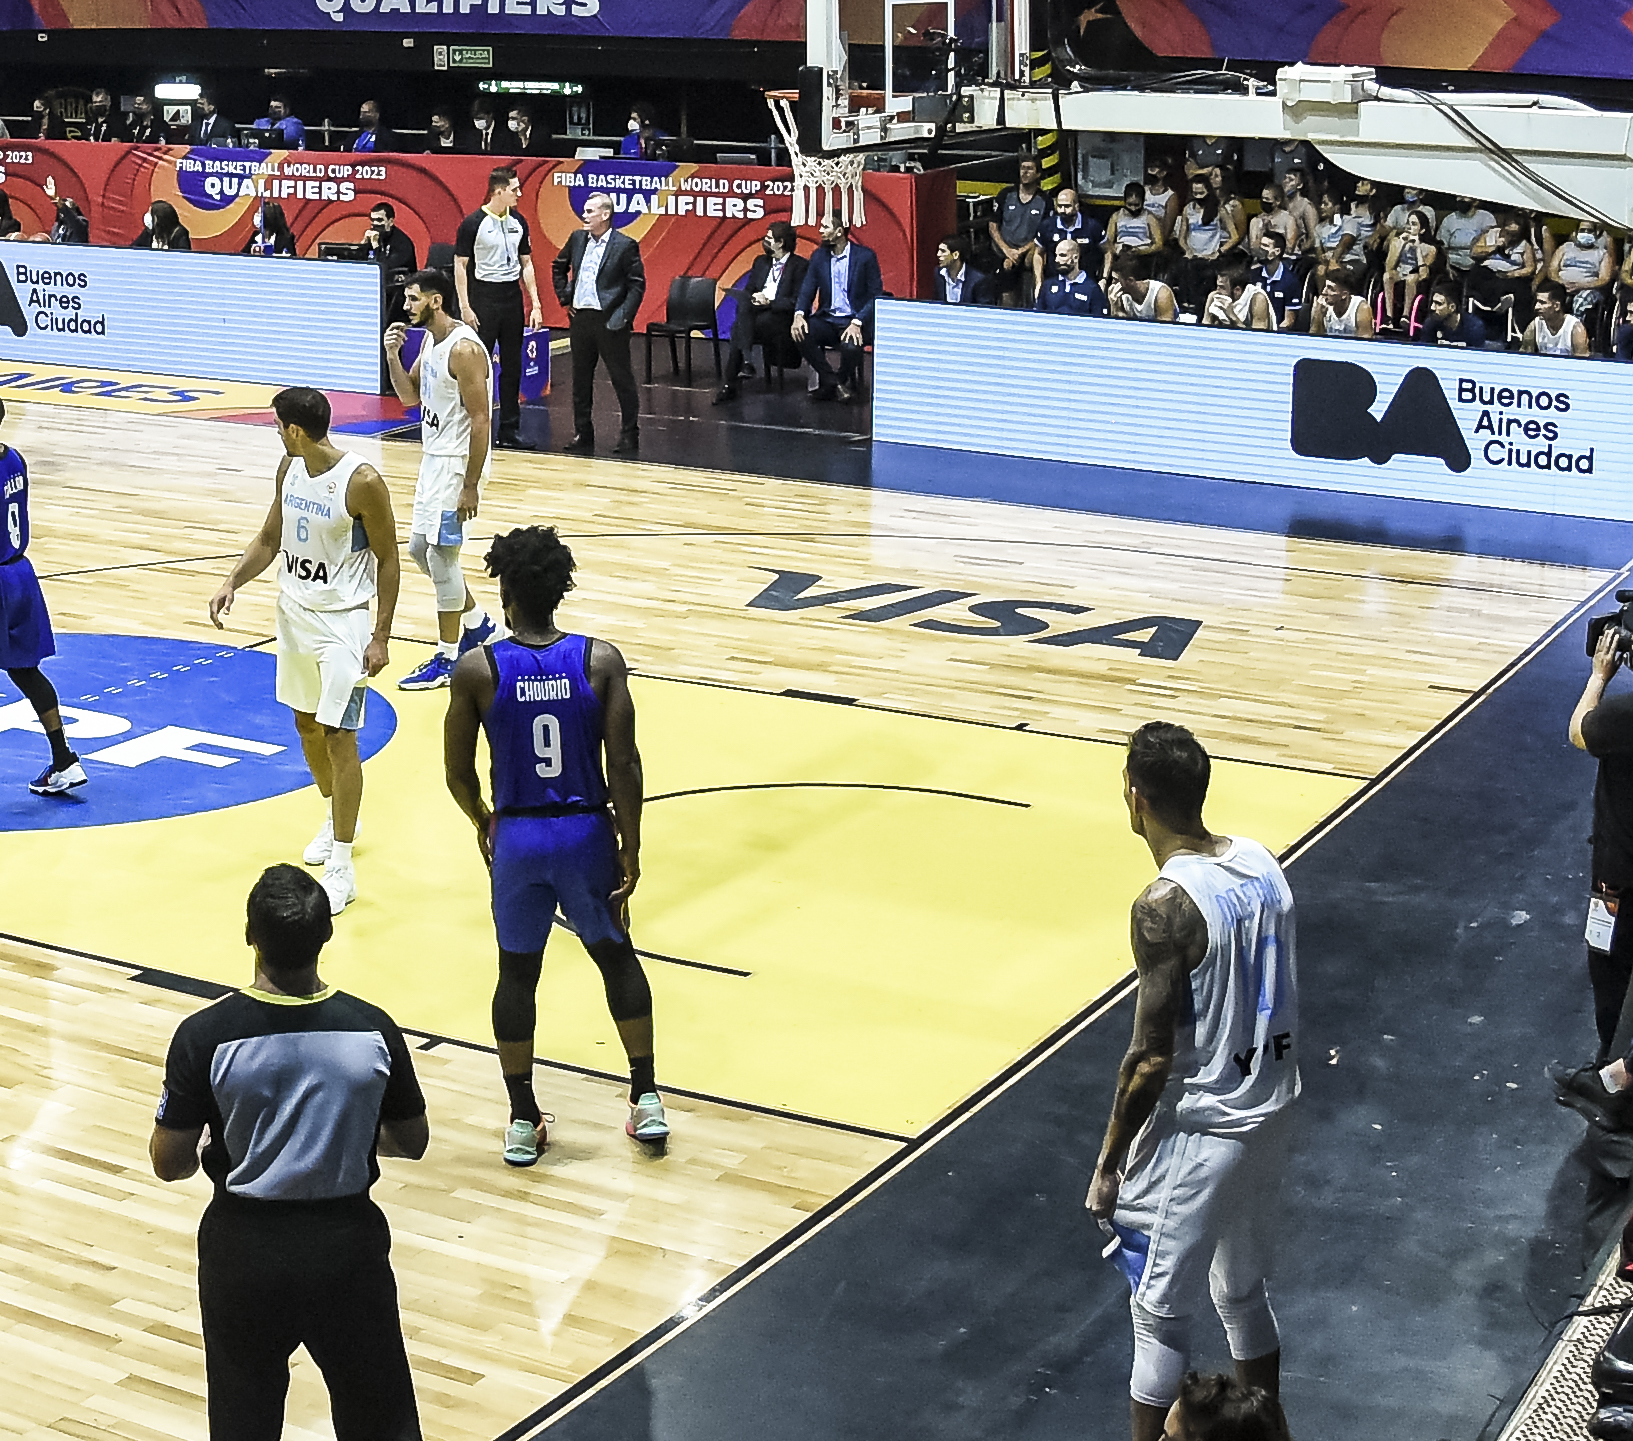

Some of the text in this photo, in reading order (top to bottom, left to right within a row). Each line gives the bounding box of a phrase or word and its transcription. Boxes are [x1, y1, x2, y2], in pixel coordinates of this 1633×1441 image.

[6, 151, 33, 164] 2023
[176, 159, 386, 180] FIBA BASKETBALL WORLD CUP 2023
[204, 176, 356, 202] QUALIFIERS
[553, 172, 584, 187] FIBA
[588, 173, 677, 191] BASKETBALL
[680, 177, 729, 193] WORLD
[732, 179, 761, 195] CUP
[15, 264, 88, 288] Buenos
[28, 288, 82, 311] Aires
[34, 310, 105, 336] Ciudad
[1457, 378, 1571, 412] Buenos
[1473, 409, 1559, 441] Aires
[1483, 439, 1595, 474] Ciudad
[283, 492, 331, 519] ARGENTINA
[296, 515, 310, 543] 6
[282, 548, 328, 585] VISA
[745, 565, 1204, 662] VISA
[516, 678, 571, 702] CHOURIO
[532, 713, 563, 778] 9
